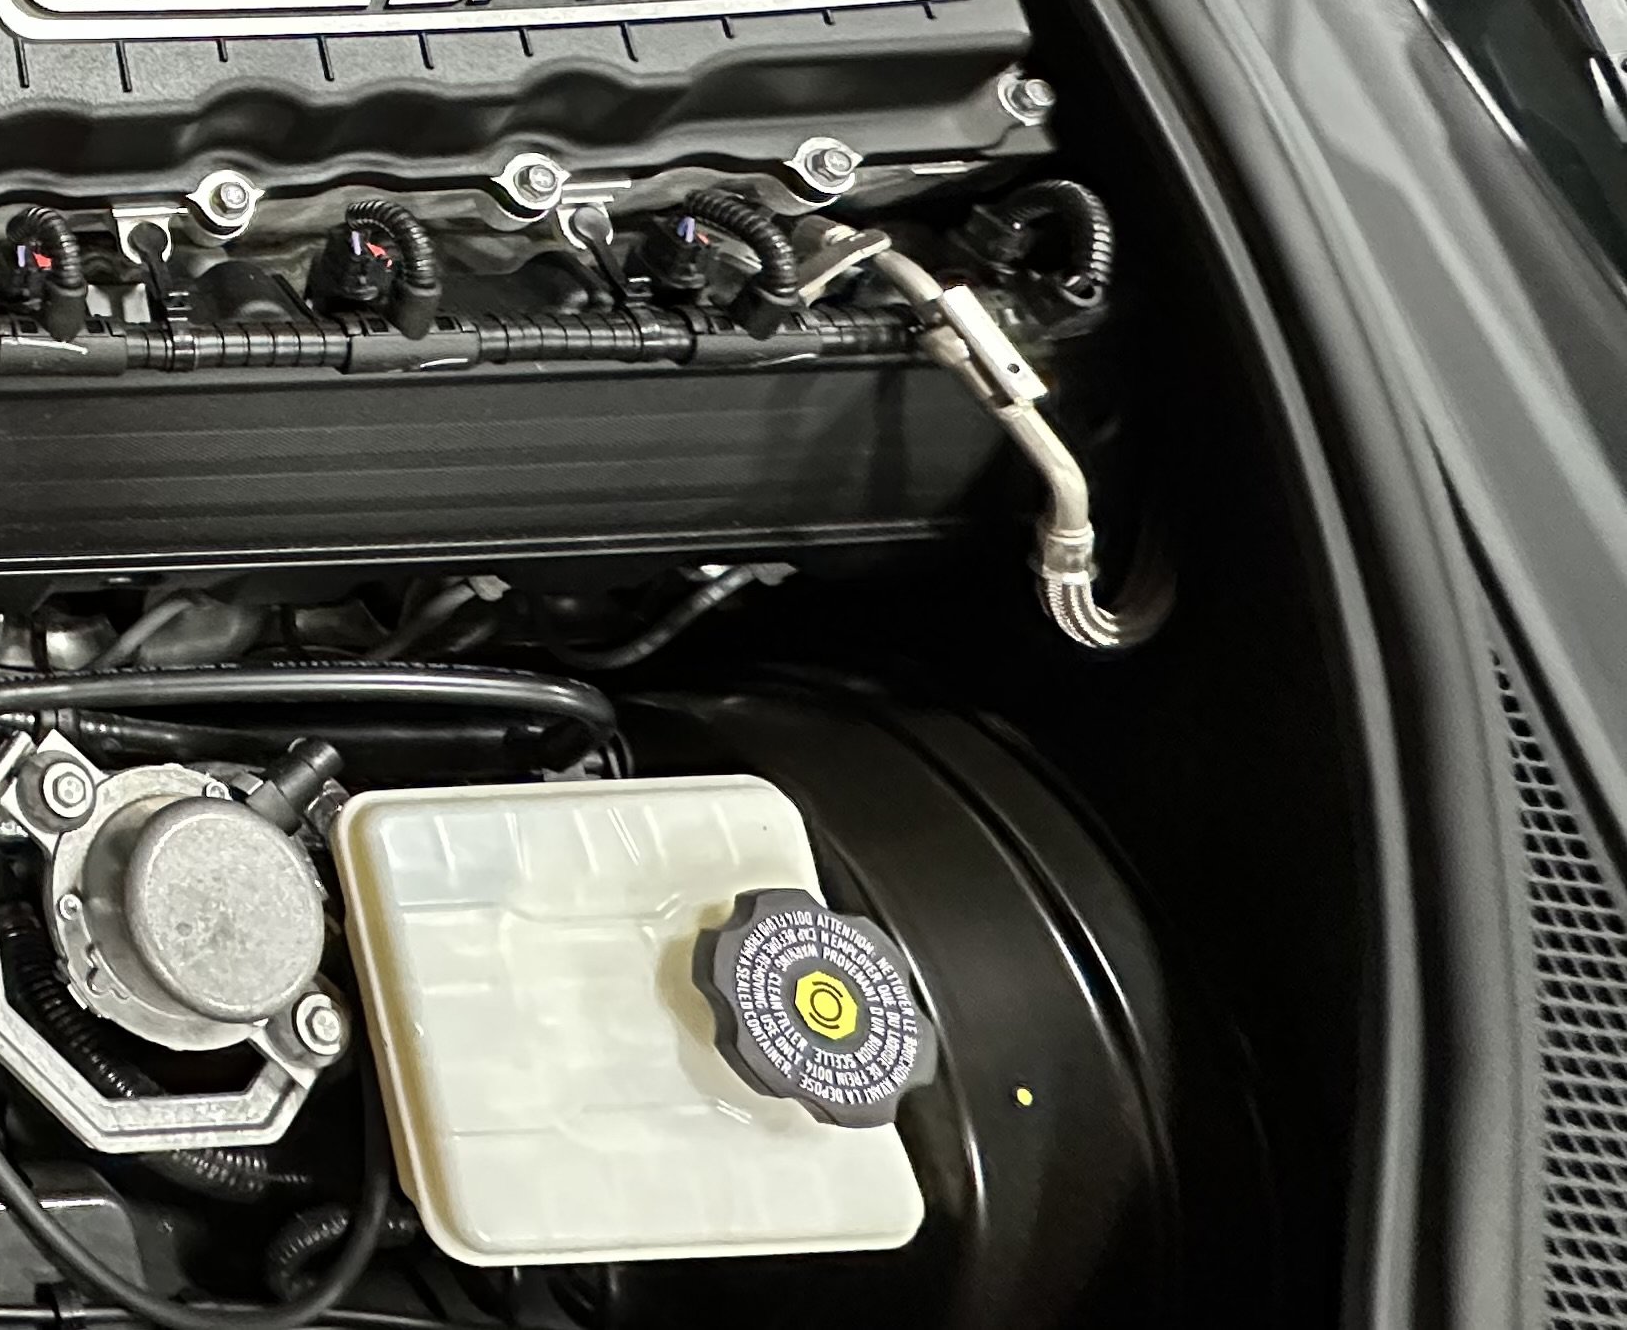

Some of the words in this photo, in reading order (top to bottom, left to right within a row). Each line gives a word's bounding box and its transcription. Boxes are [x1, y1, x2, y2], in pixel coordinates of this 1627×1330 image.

[784, 910, 813, 926] DOT4
[739, 927, 765, 960] FROM
[761, 928, 798, 958] BEFORE
[796, 927, 818, 942] CAP
[738, 954, 752, 966] A
[822, 945, 882, 1002] PROVENANT
[876, 956, 915, 1017] NETTOYER
[735, 964, 754, 1010] SEALED
[767, 971, 784, 1011] CLEAN
[877, 983, 897, 1008] QUE
[759, 1013, 781, 1038] USE
[773, 1010, 809, 1052] FILLER
[885, 1011, 901, 1029] DU
[903, 1018, 918, 1035] LE
[774, 1036, 804, 1066] ONLY
[803, 1059, 834, 1085] DOT4
[844, 1088, 864, 1105] LA
